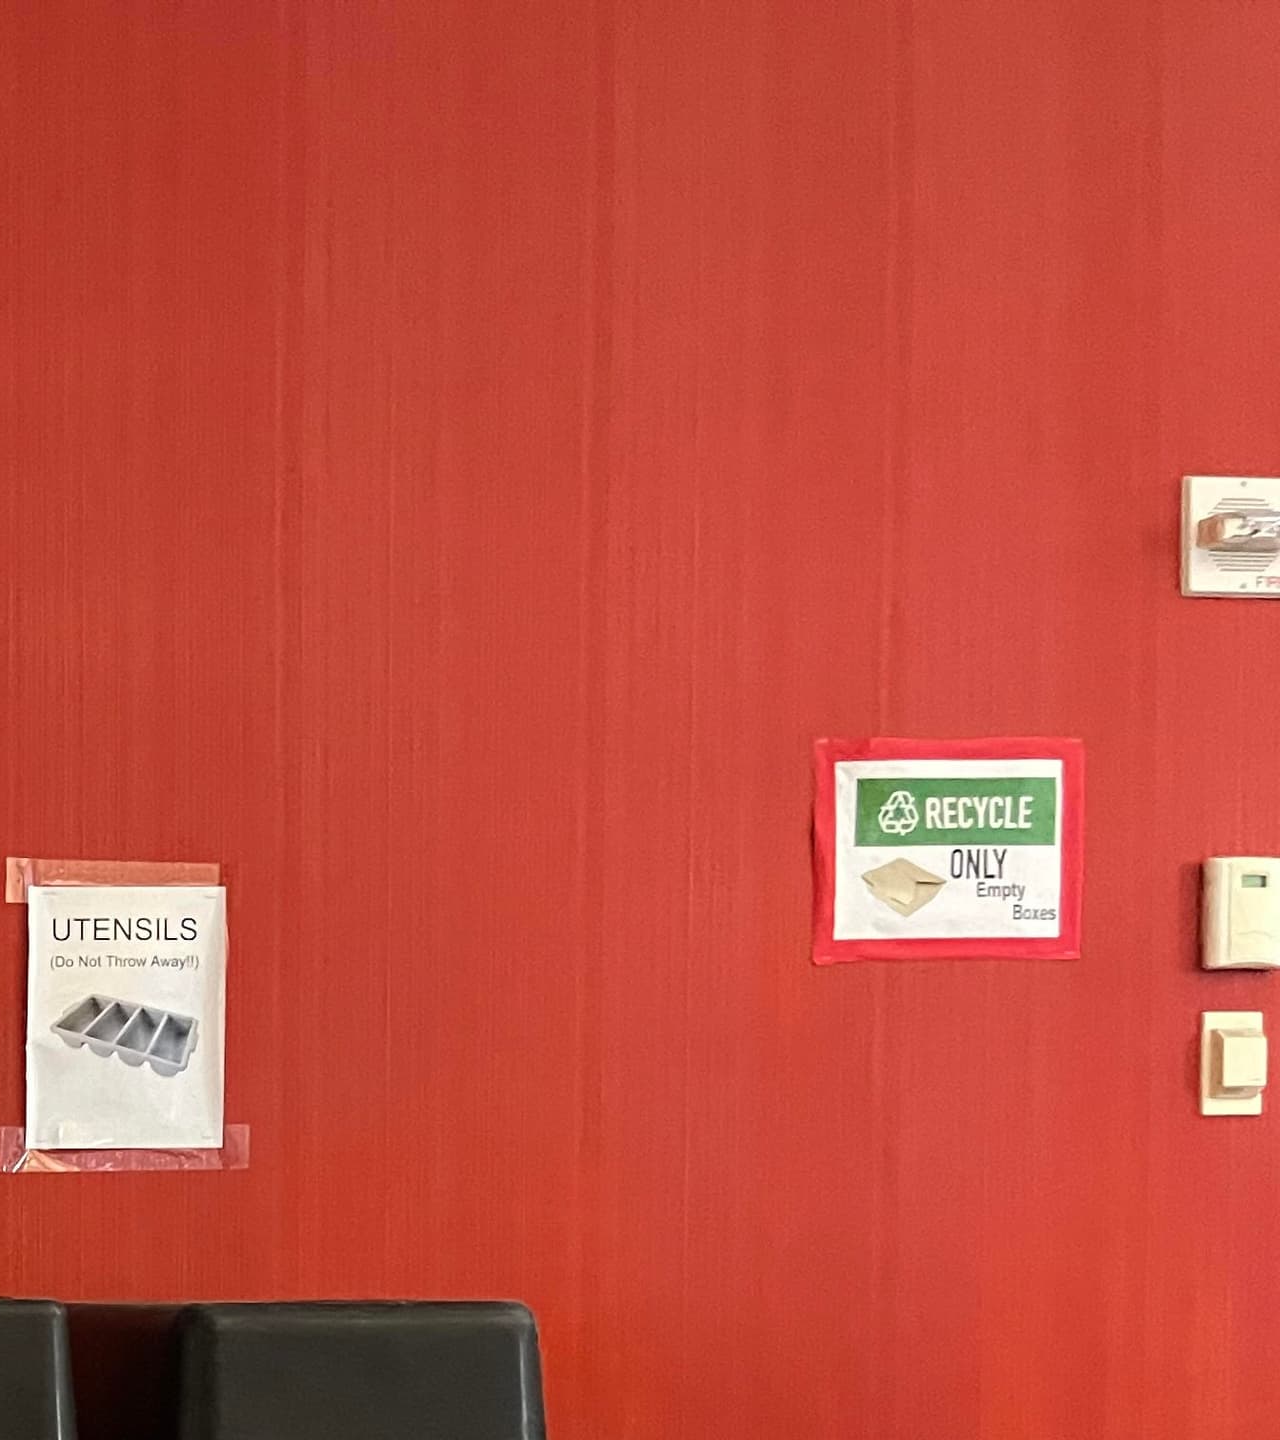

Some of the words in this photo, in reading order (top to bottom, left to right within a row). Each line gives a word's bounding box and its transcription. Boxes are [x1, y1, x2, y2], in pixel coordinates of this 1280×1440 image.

[925, 796, 1034, 829] RECYCLE
[950, 849, 1007, 880] ONLY
[976, 882, 1026, 901] Empty
[1012, 904, 1057, 921] Boxes
[52, 917, 198, 941] UTENSILS
[50, 955, 74, 970] (Do
[78, 955, 102, 968] Not
[106, 955, 147, 968] Throw
[150, 955, 200, 970] Away!!)
